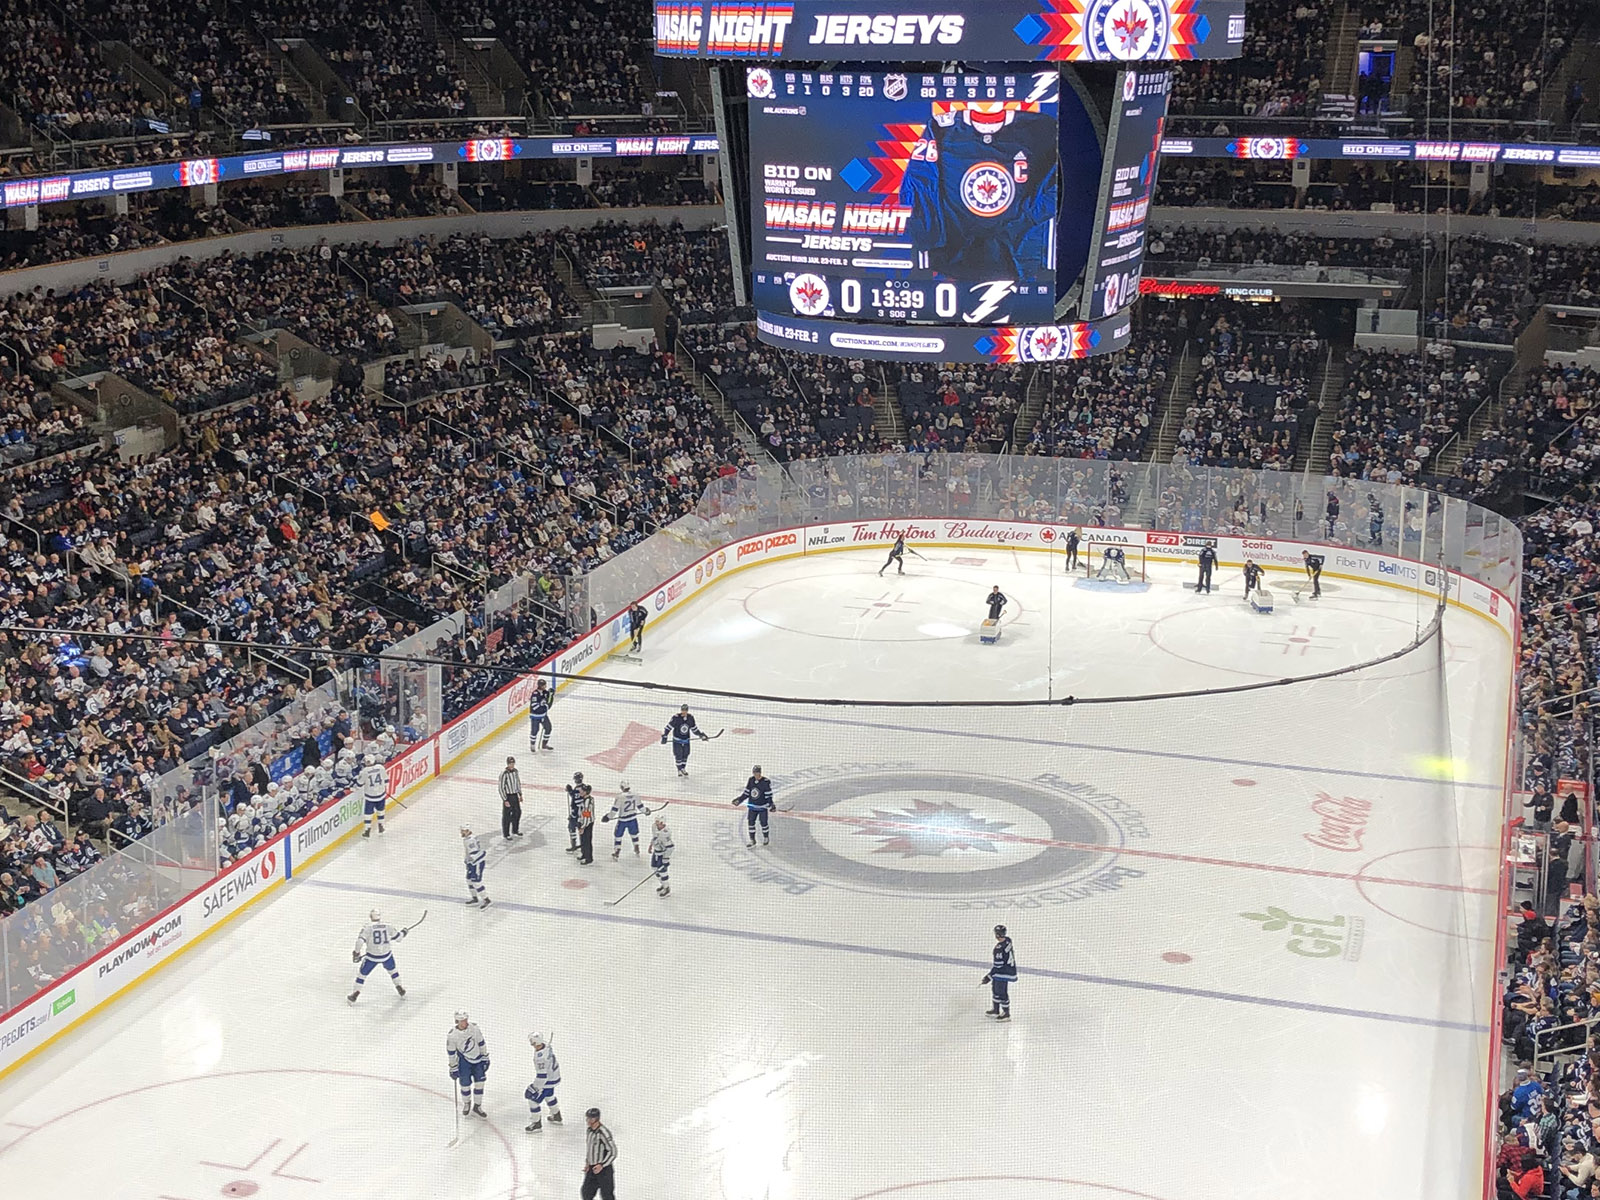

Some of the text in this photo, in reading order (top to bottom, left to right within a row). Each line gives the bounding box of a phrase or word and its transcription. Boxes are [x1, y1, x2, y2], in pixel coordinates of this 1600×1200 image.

[657, 8, 965, 49] WASAC NIGHT JERSEYS
[787, 84, 795, 95] 2
[804, 85, 811, 95] 1
[822, 86, 830, 96] 0
[858, 86, 874, 97] 20
[920, 87, 1014, 98] 80 2 3 0 2
[552, 144, 571, 152] BID
[573, 143, 588, 151] ON
[616, 140, 654, 154] WASAC
[655, 139, 690, 153] NIGHT
[692, 140, 719, 150] JERS
[911, 138, 938, 162] 26
[1342, 146, 1364, 154] BID
[1366, 147, 1383, 155] ON
[1415, 144, 1460, 159] WASAC
[1461, 146, 1500, 160] NIGHT
[1502, 148, 1555, 160] JERSEYS
[283, 152, 307, 171] WASAC
[309, 150, 339, 169] NIGHT
[342, 151, 384, 164] JERSEYS
[764, 164, 832, 181] BID ON
[1013, 160, 1028, 183] C
[4, 183, 39, 205] WASAC
[41, 178, 70, 201] NIGHT
[72, 176, 110, 194] JERSEYS
[764, 201, 912, 234] WASAC NIGHT
[801, 234, 873, 252] JERSEYS
[1139, 279, 1273, 296] Budweiser KING CLUB
[840, 279, 862, 314] 0
[871, 288, 924, 309] 13:39
[935, 283, 957, 318] 0
[889, 310, 906, 318] SOG
[812, 331, 819, 343] 2
[851, 524, 877, 542] Tim
[944, 522, 1032, 541] Budweiser
[1081, 533, 1128, 543] CANADA
[1148, 535, 1177, 544] TSN
[1242, 540, 1273, 550] Scotia
[1242, 551, 1304, 564] Wealth Manage
[1336, 556, 1371, 570] Fibe TV
[561, 643, 593, 673] Payworks
[368, 773, 383, 787] 14
[624, 800, 636, 812] 21
[203, 863, 260, 918] SAFEWAY
[373, 930, 389, 945] 81
